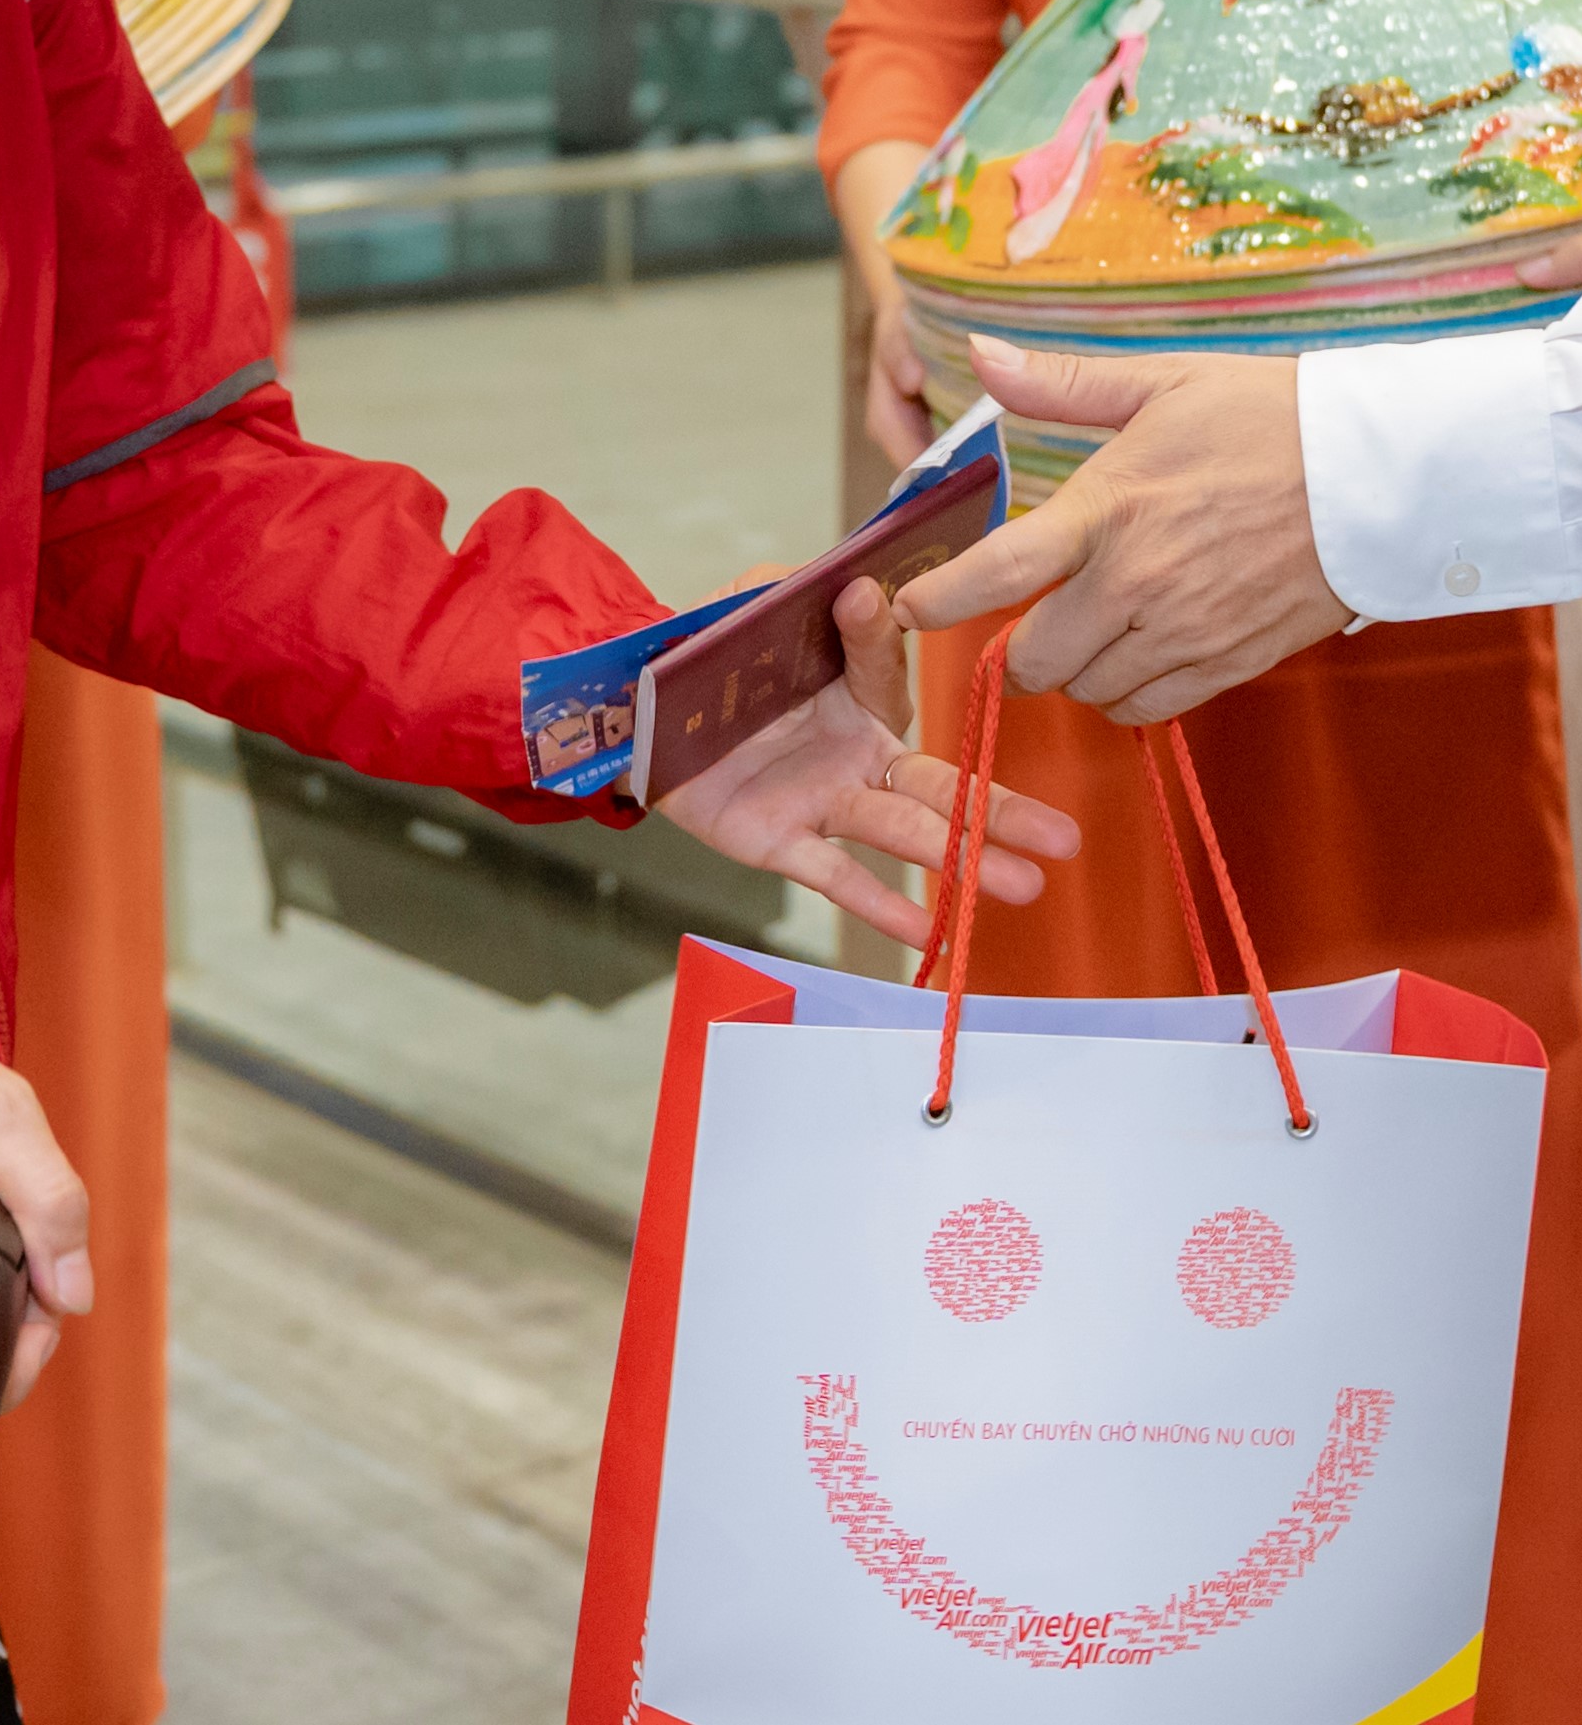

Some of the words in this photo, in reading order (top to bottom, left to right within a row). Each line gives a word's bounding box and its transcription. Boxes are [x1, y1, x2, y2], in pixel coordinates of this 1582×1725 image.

[982, 1422, 1016, 1440] BAY
[1022, 1421, 1091, 1441] CHUYÊN
[1098, 1421, 1136, 1442] CHỞ
[1217, 1427, 1243, 1449] NỤ
